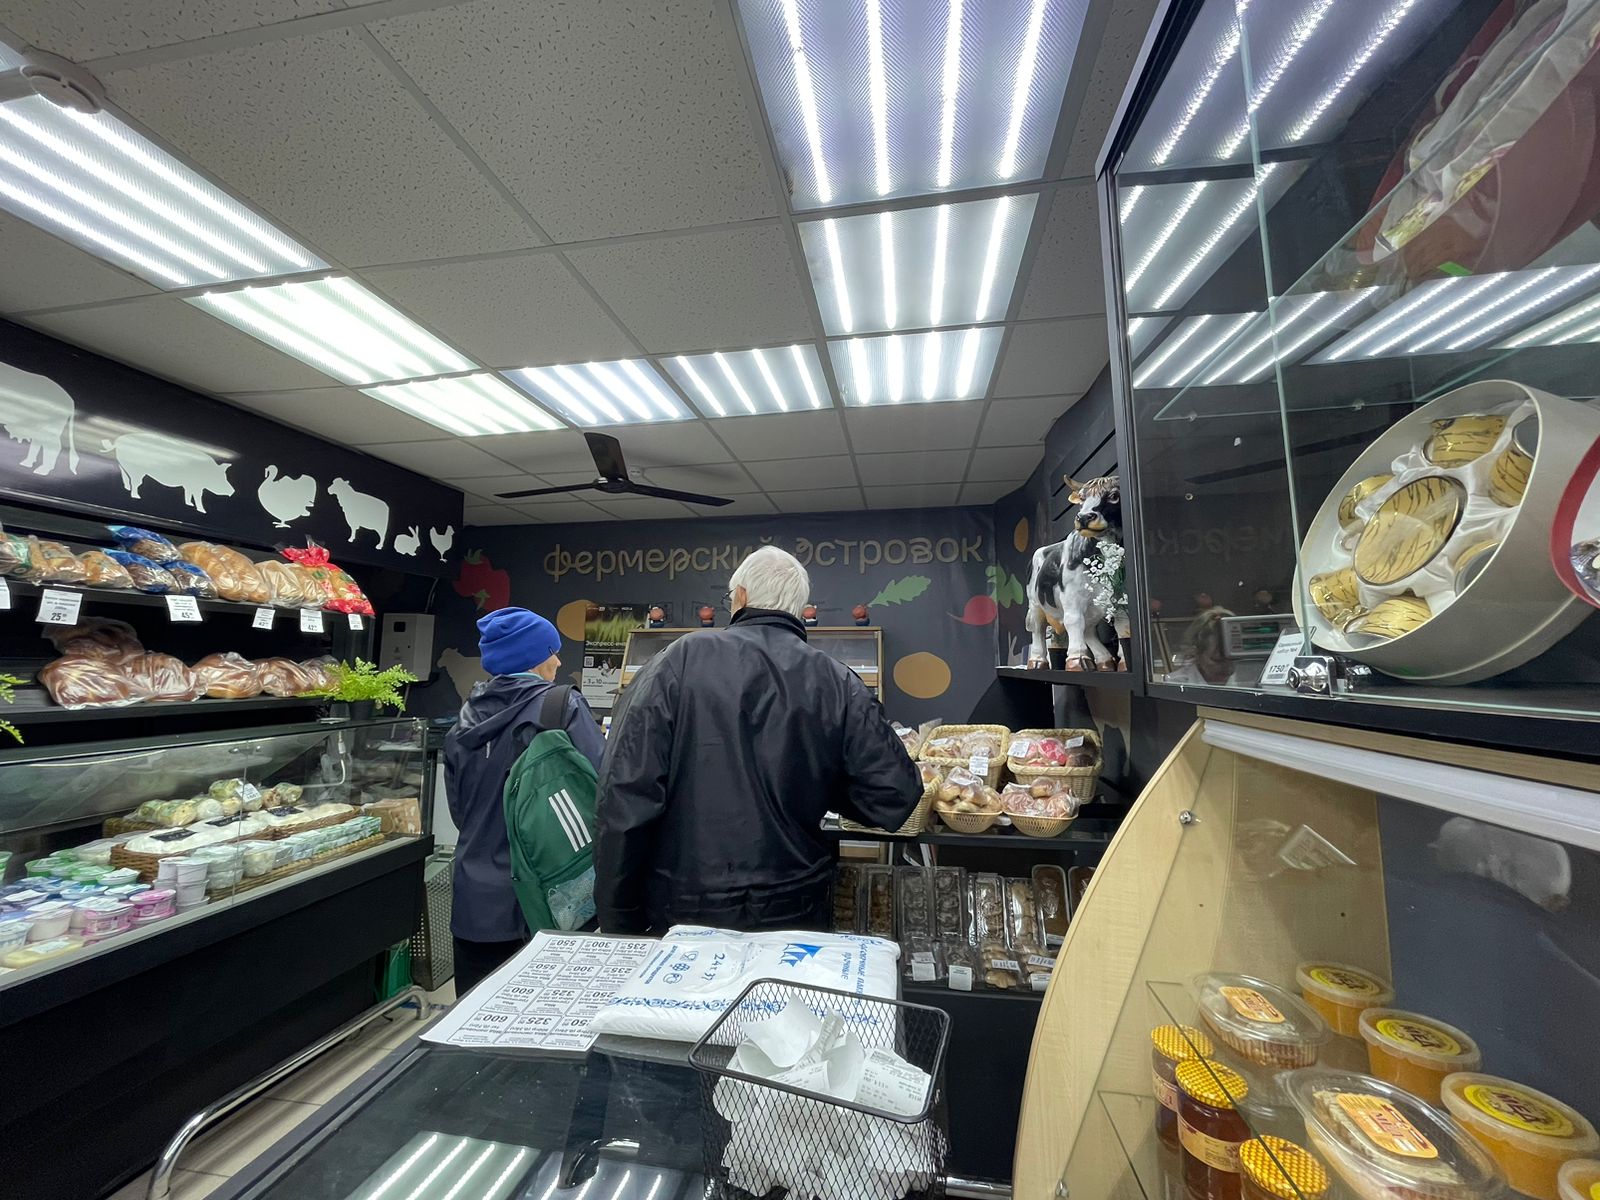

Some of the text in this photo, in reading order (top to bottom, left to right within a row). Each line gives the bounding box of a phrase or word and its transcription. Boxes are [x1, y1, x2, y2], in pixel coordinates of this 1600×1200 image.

[556, 939, 577, 947] 550
[552, 989, 575, 997] 325
[482, 1014, 508, 1023] 600
[526, 1016, 553, 1026] 325
